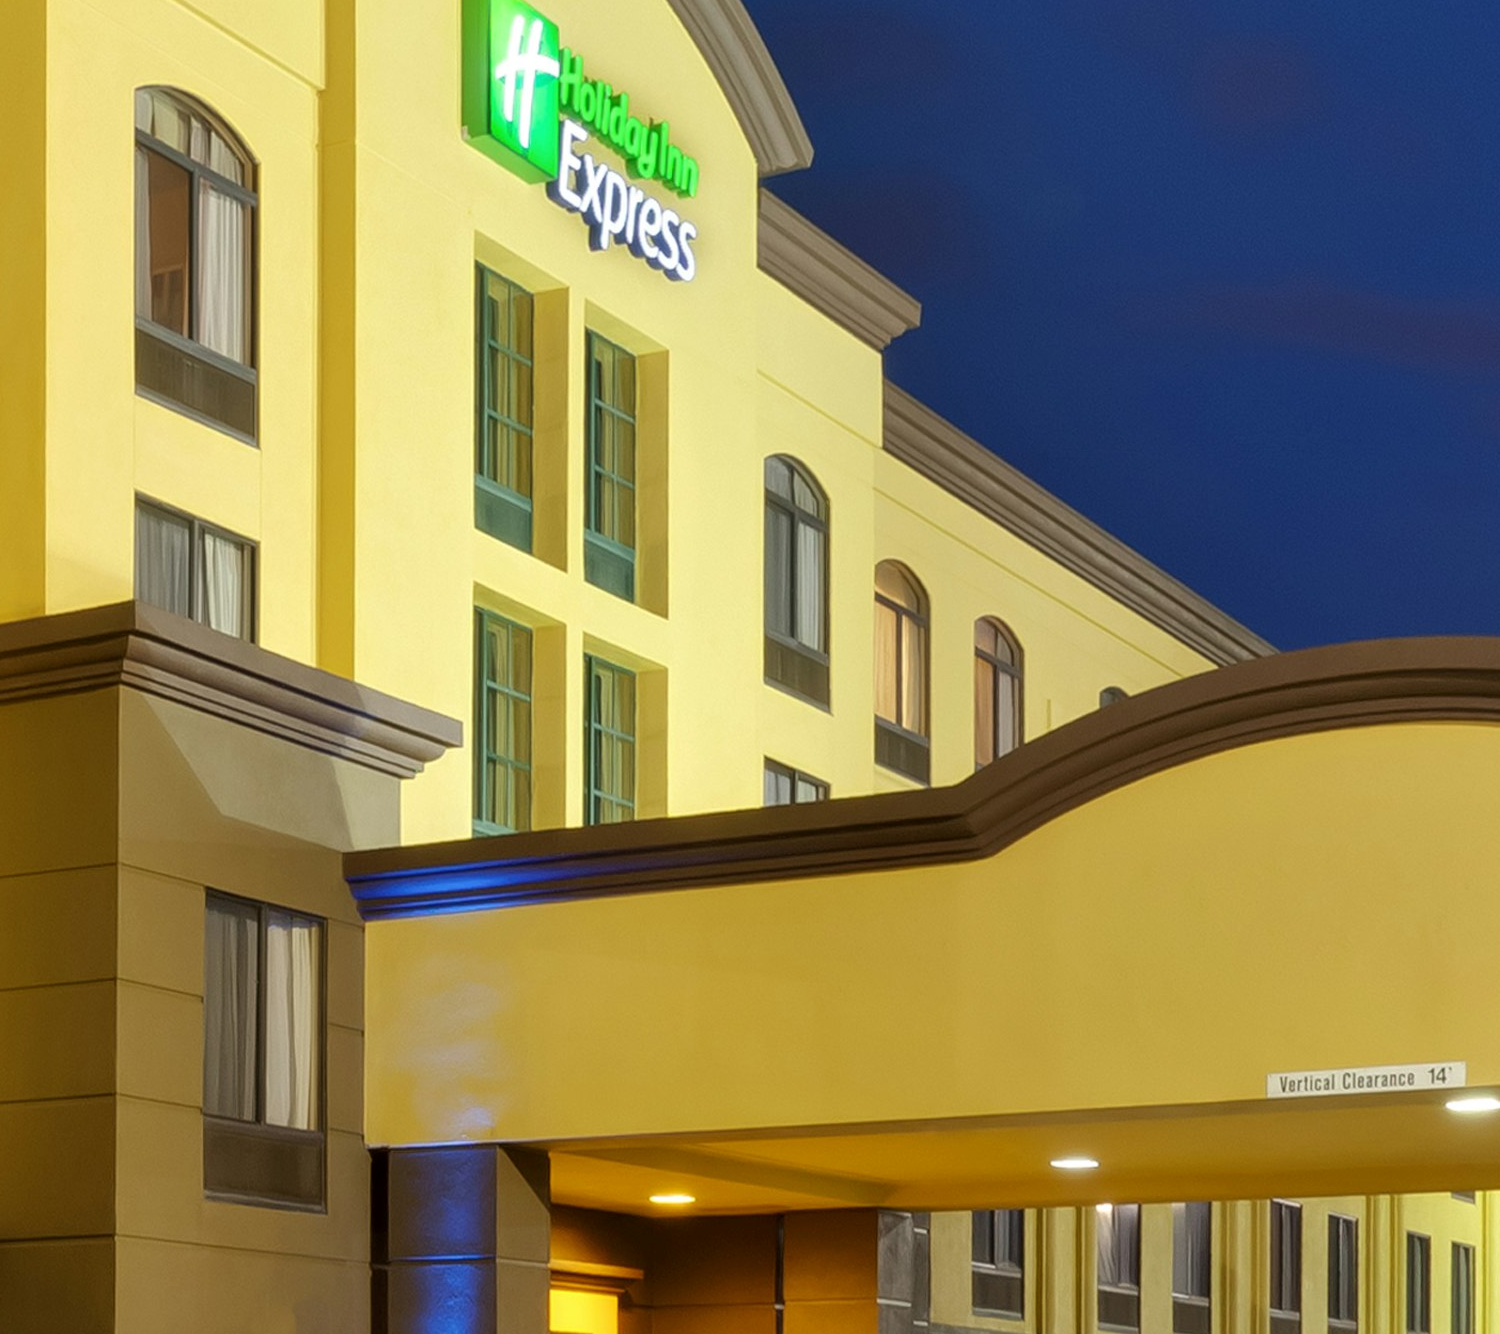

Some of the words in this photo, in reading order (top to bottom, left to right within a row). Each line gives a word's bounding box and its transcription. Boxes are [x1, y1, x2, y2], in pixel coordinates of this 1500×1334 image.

[559, 47, 658, 179] Holiday
[660, 121, 699, 197] Inn
[559, 119, 697, 282] Express
[1279, 1074, 1335, 1093] Vertical
[1342, 1071, 1415, 1090] Clearance
